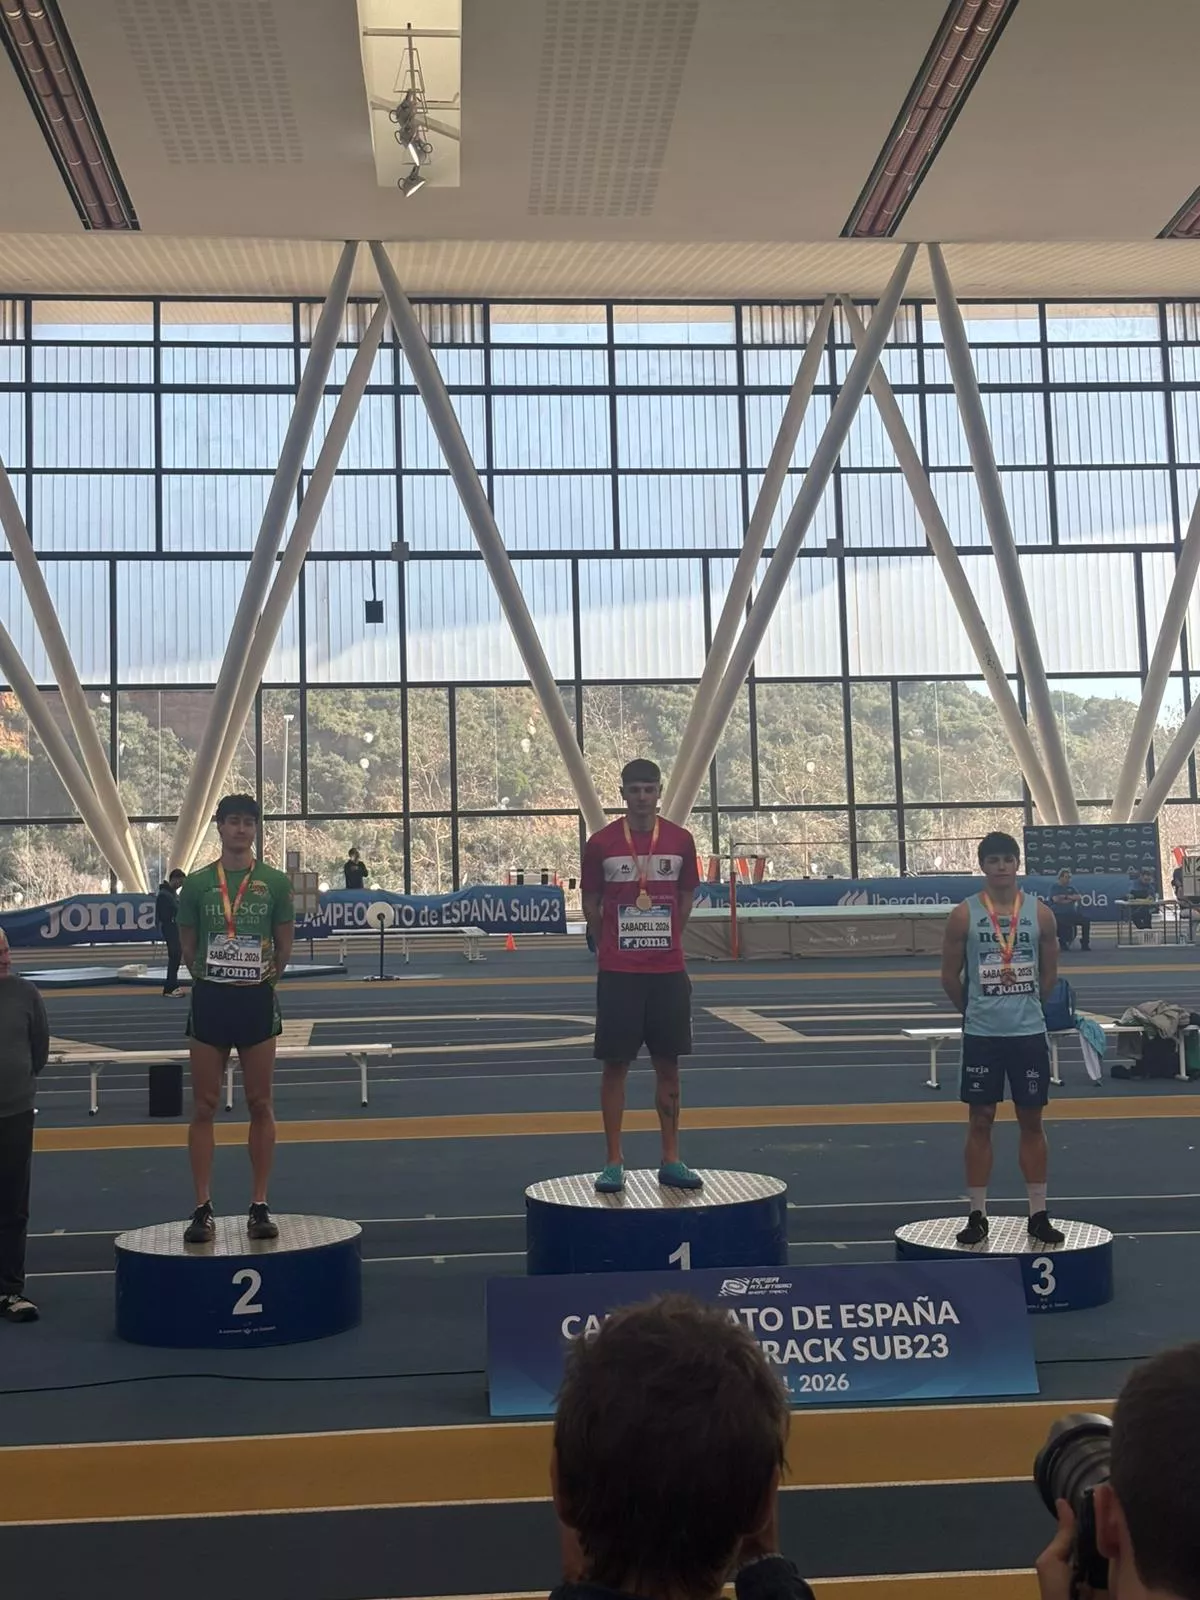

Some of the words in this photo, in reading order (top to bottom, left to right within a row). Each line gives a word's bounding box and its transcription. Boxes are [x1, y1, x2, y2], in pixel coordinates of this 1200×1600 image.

[294, 902, 416, 928] AMPEOTO
[419, 905, 438, 926] de
[442, 894, 508, 924] ESPAÑA
[510, 898, 560, 922] Sub23
[621, 922, 654, 931] SABADELL
[655, 922, 669, 931] 2026
[209, 950, 243, 962] SABADELL
[244, 952, 260, 962] 2026
[668, 1241, 691, 1270] 1
[1031, 1256, 1056, 1296] 3
[231, 1268, 263, 1315] 2
[791, 1304, 834, 1332] DE
[839, 1295, 961, 1329] ESPAÑA
[852, 1333, 950, 1362] SUB23
[799, 1372, 850, 1393] 2026
